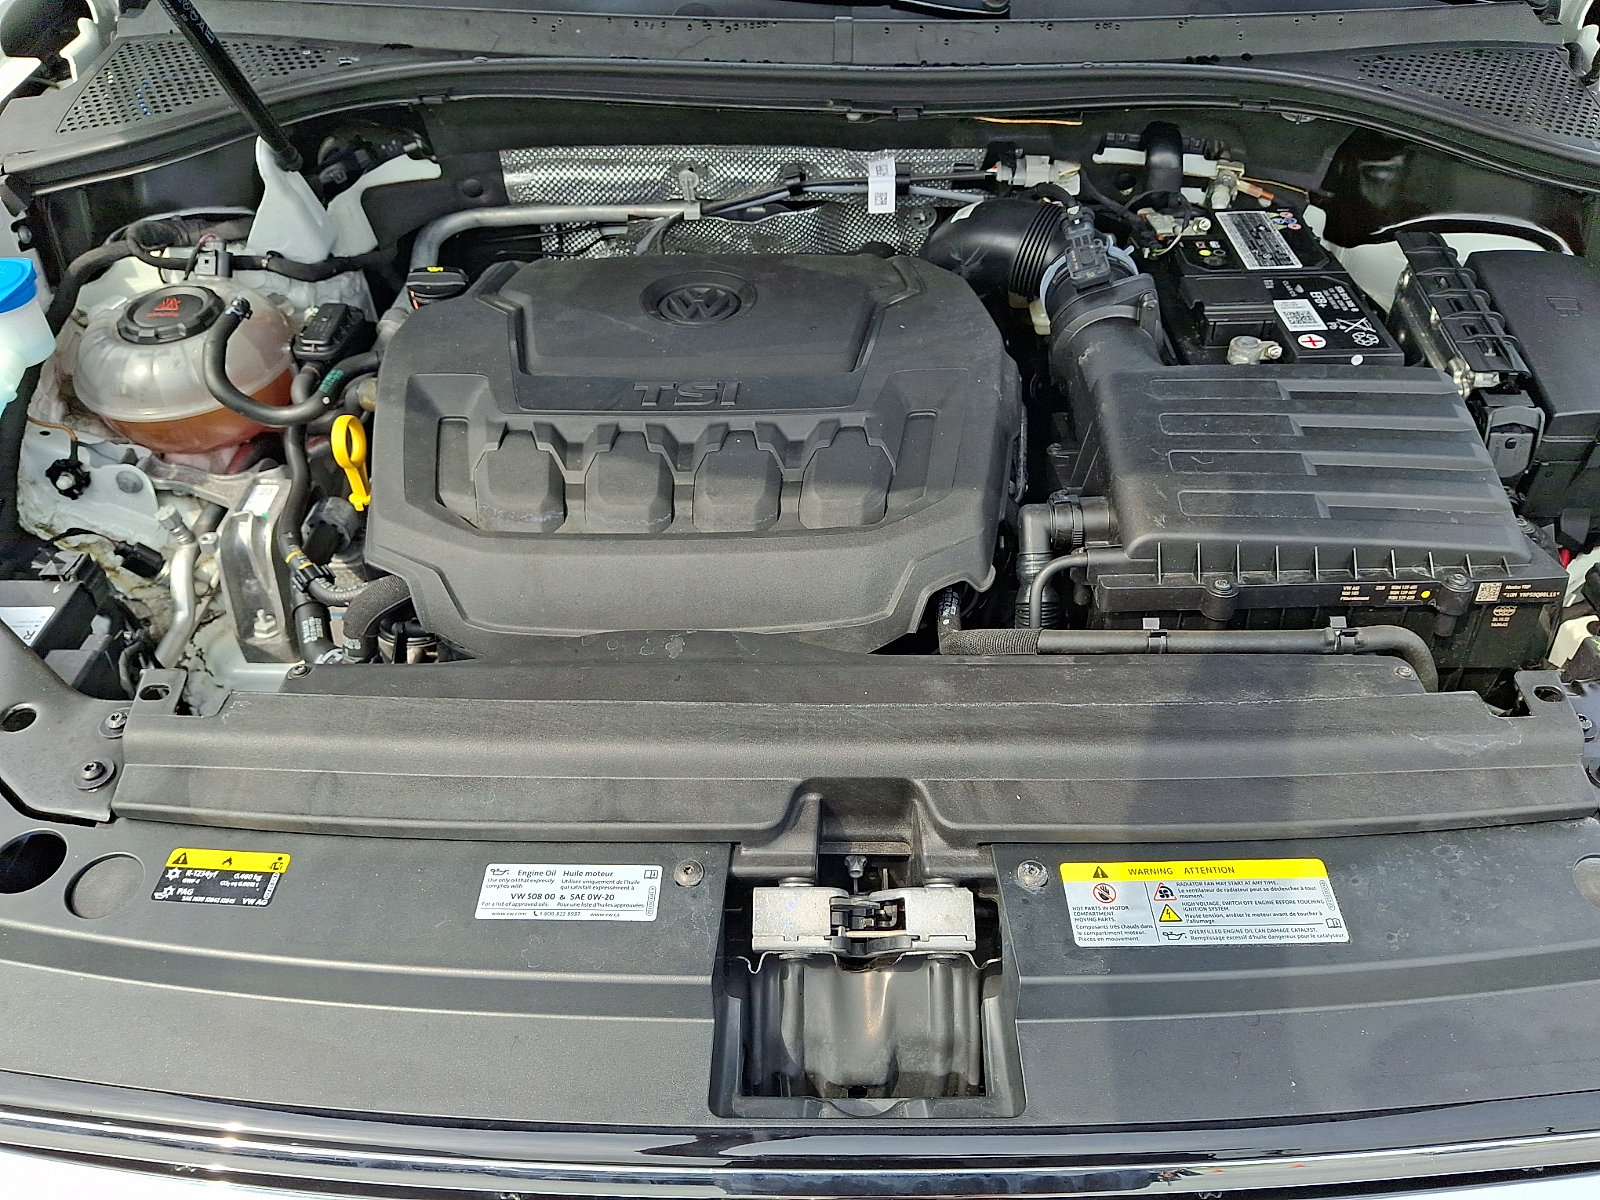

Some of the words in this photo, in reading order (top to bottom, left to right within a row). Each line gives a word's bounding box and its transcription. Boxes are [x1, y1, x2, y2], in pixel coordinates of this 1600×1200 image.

[633, 382, 743, 406] TSI
[185, 870, 219, 879] R-1234yf
[518, 869, 544, 878] Engine
[545, 869, 557, 877] Oil
[1127, 867, 1174, 876] WARNING
[1184, 866, 1235, 875] ATTENTION
[255, 898, 268, 906] AG
